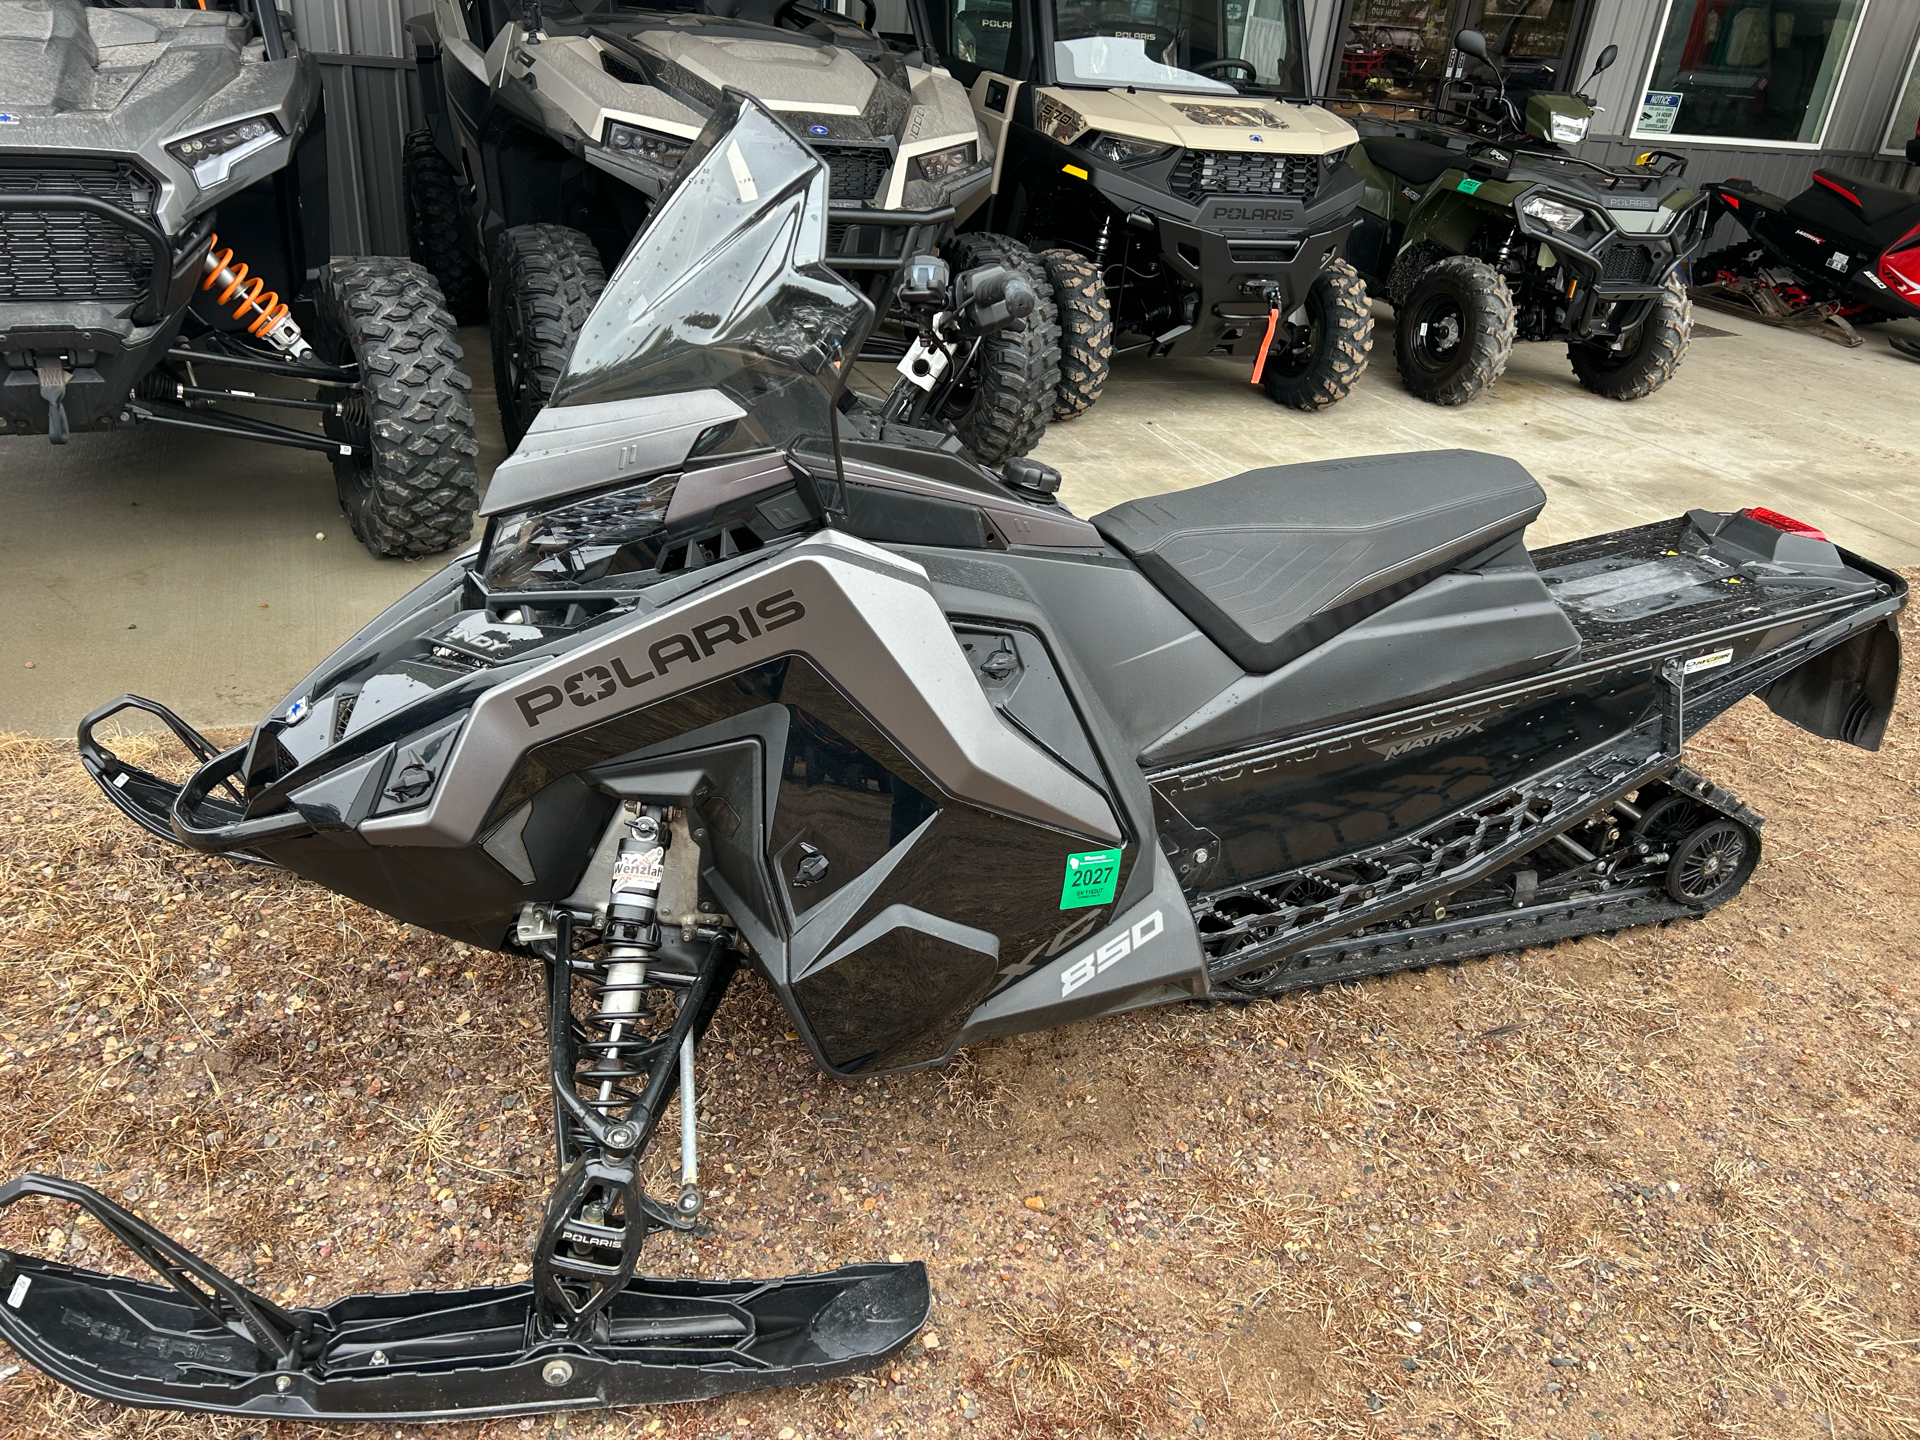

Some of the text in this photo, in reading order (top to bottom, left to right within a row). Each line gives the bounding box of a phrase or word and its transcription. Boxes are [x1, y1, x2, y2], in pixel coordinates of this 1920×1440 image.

[1115, 31, 1156, 41] POLARIS
[508, 39, 537, 69] XP
[1650, 95, 1671, 105] NOTICE
[909, 106, 926, 140] 1000
[1042, 104, 1073, 126] 570
[1213, 207, 1294, 221] POLARIS
[1611, 198, 1651, 208] POLARIS
[446, 627, 510, 651] INDY
[514, 588, 806, 728] POLARIS
[1383, 718, 1486, 761] MATRYX
[1071, 866, 1113, 887] 2027
[983, 908, 1103, 999] XC
[1061, 909, 1164, 999] 850
[562, 1231, 622, 1249] POLARIS
[61, 1307, 232, 1362] POLARIS
